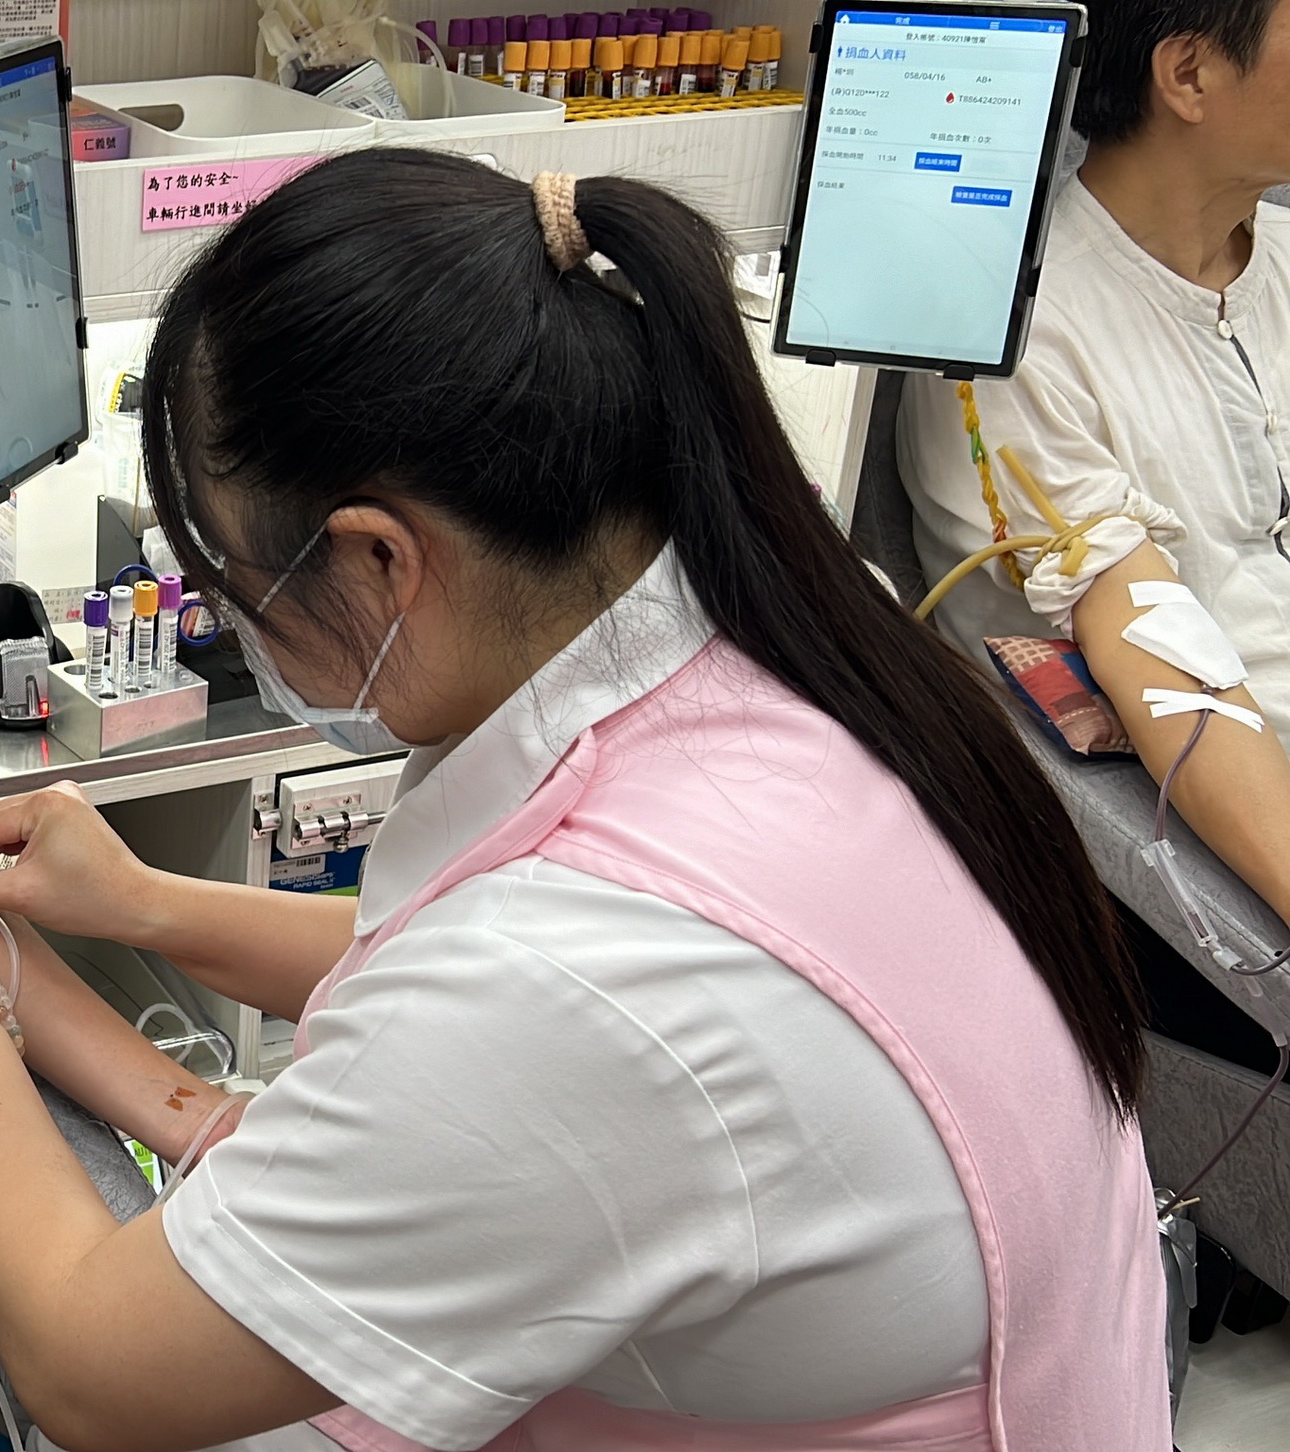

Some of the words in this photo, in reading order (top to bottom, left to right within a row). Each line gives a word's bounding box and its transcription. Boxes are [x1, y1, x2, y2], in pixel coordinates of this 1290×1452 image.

[845, 46, 906, 61] 捐血人資料
[904, 71, 946, 81] 058/04/16
[975, 76, 992, 84] AB+
[828, 107, 867, 117] 全血500cc
[83, 136, 116, 151] 仁義號
[147, 172, 239, 192] 為了您的安全~
